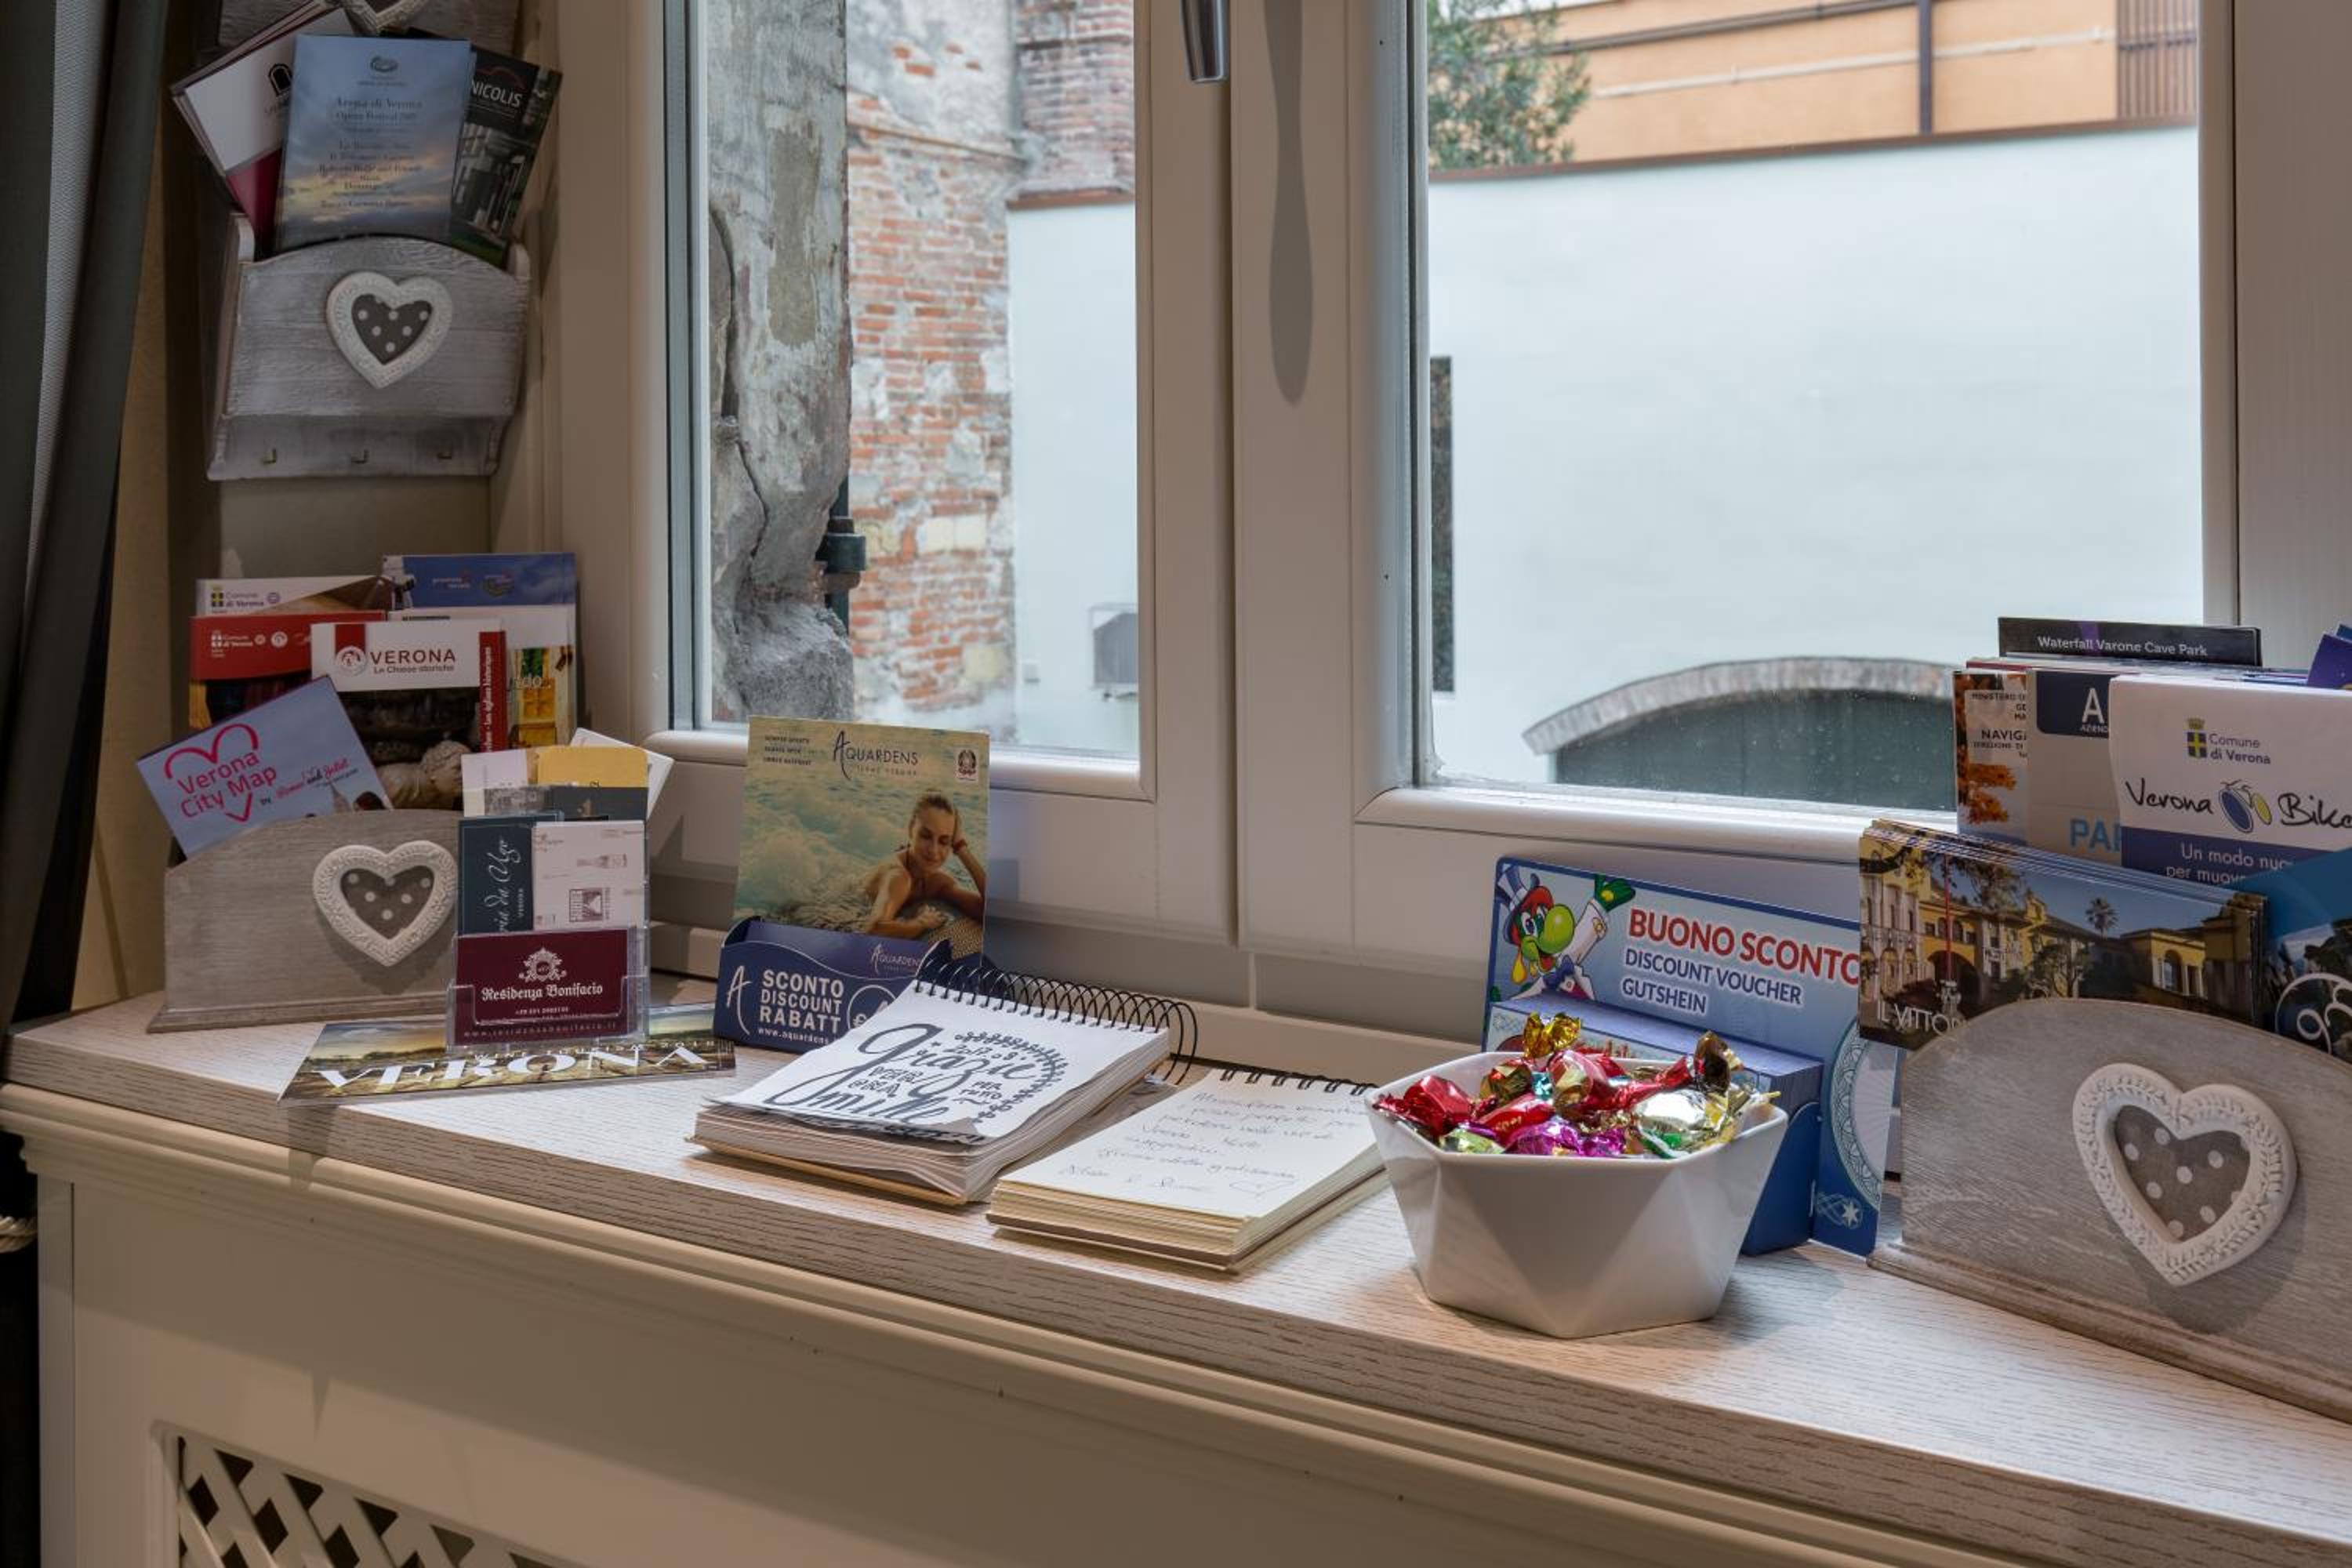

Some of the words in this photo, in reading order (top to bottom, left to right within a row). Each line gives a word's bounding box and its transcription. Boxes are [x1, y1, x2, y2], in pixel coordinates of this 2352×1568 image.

[470, 77, 524, 108] NICOLIS
[369, 648, 456, 665] VERONA
[2038, 635, 2093, 650] Waterfall
[2096, 639, 2141, 653] Varone
[2144, 641, 2176, 655] Cave
[2179, 643, 2208, 657] Park
[833, 729, 919, 781] AQUARDENS
[2209, 733, 2261, 749] Comune
[2210, 750, 2223, 760] di
[2226, 750, 2271, 765] Verona
[177, 751, 260, 795] Verona
[180, 789, 224, 818] City
[227, 766, 278, 797] Map
[2125, 777, 2215, 815] Verona
[2181, 842, 2202, 861] Un
[2208, 846, 2254, 867] modo
[2165, 866, 2192, 879] per
[1629, 909, 1735, 956] BUONO
[1740, 931, 1859, 985] SCONTO
[761, 967, 844, 999] SCONTO
[1625, 948, 1713, 984] DISCOUNT
[1716, 967, 1802, 1004] VOUCHER
[481, 985, 543, 1002] Residenza
[546, 982, 604, 998] Bonifacio
[760, 987, 843, 1015] DISCOUNT
[1623, 978, 1707, 1014] GUTSHEIN
[759, 1005, 841, 1034] RABATT
